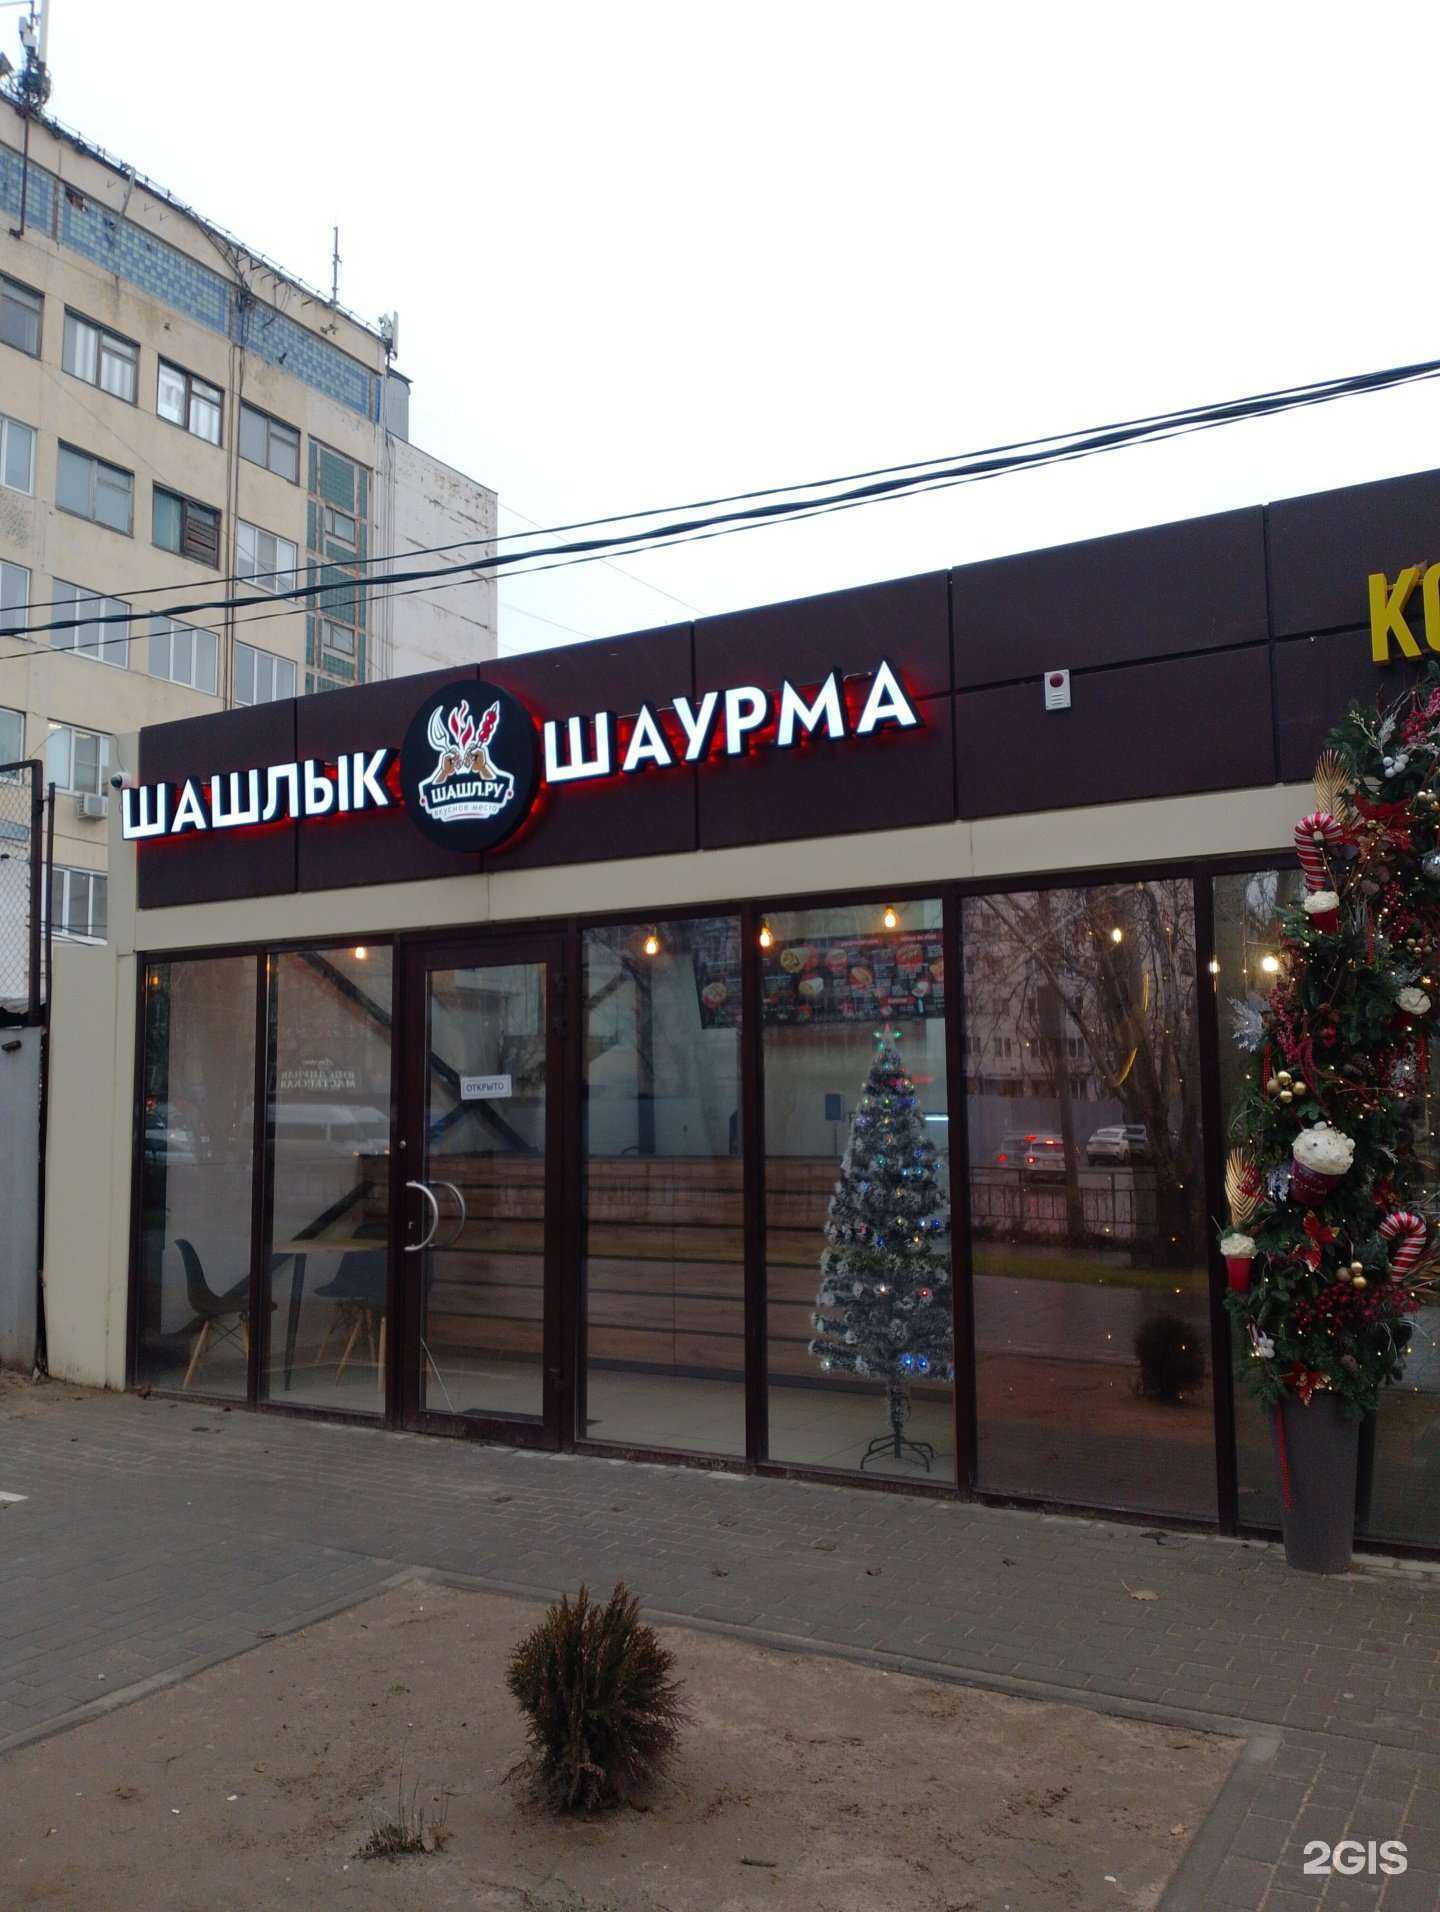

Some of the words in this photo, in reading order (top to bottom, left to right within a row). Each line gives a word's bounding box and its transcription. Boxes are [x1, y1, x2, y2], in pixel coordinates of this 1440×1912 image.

[544, 660, 918, 783] ШАУРМА
[122, 748, 391, 840] ШАШЛЫК
[431, 782, 504, 803] ШАШЛ.РУ
[465, 1081, 505, 1093] ОТКРЫТО
